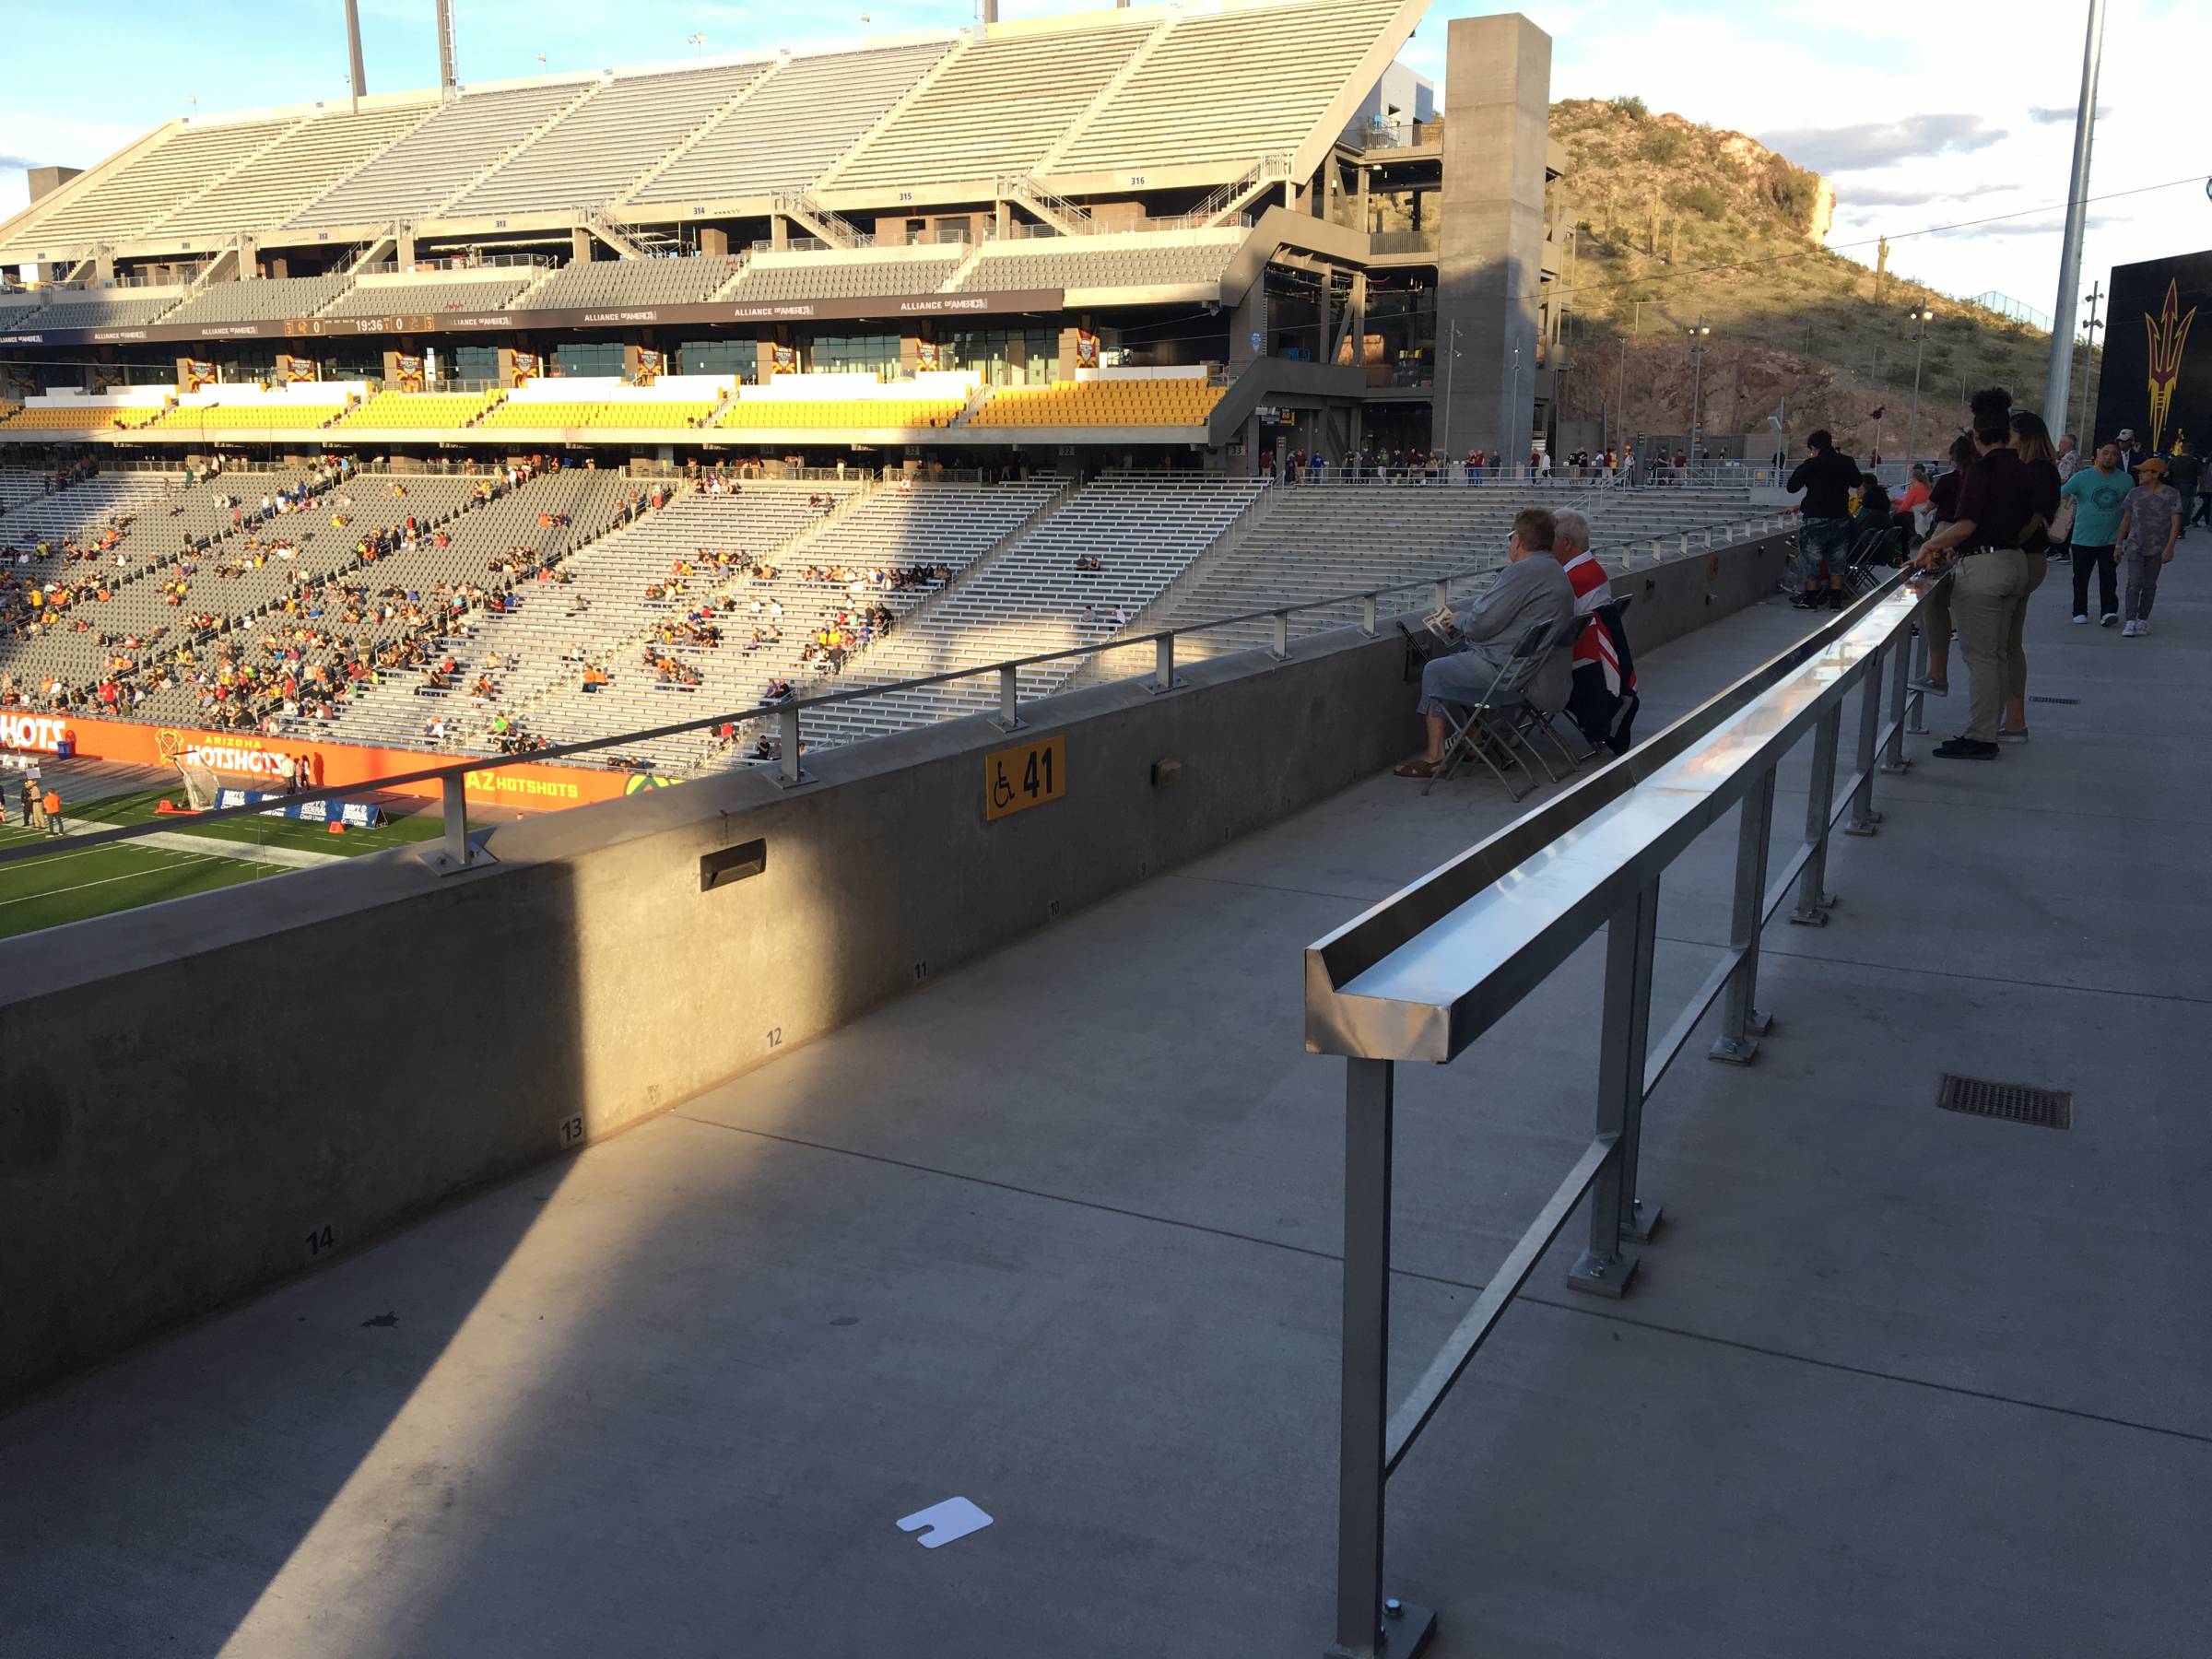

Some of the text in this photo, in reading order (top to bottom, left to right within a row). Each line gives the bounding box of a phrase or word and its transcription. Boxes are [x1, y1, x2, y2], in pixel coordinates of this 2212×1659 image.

[1131, 176, 1145, 185] 316
[900, 193, 912, 201] 315
[735, 308, 772, 316] ALLIANCE
[900, 301, 942, 311] ALLIANCE
[313, 321, 321, 333] 0
[356, 319, 383, 332] 19:36
[395, 318, 403, 330] 0
[1230, 446, 1241, 455] 33
[206, 735, 262, 749] ARIZONA
[1023, 747, 1053, 798] 41
[465, 771, 579, 799] AZ HOTSHOTS
[300, 805, 326, 817] FEDERAL
[344, 803, 360, 812] NAVY
[342, 810, 368, 821] FEDERAL
[1050, 900, 1060, 917] 10
[914, 960, 926, 979] 11
[767, 1027, 782, 1048] 12
[561, 1117, 582, 1142] 13
[305, 1225, 335, 1255] 14
